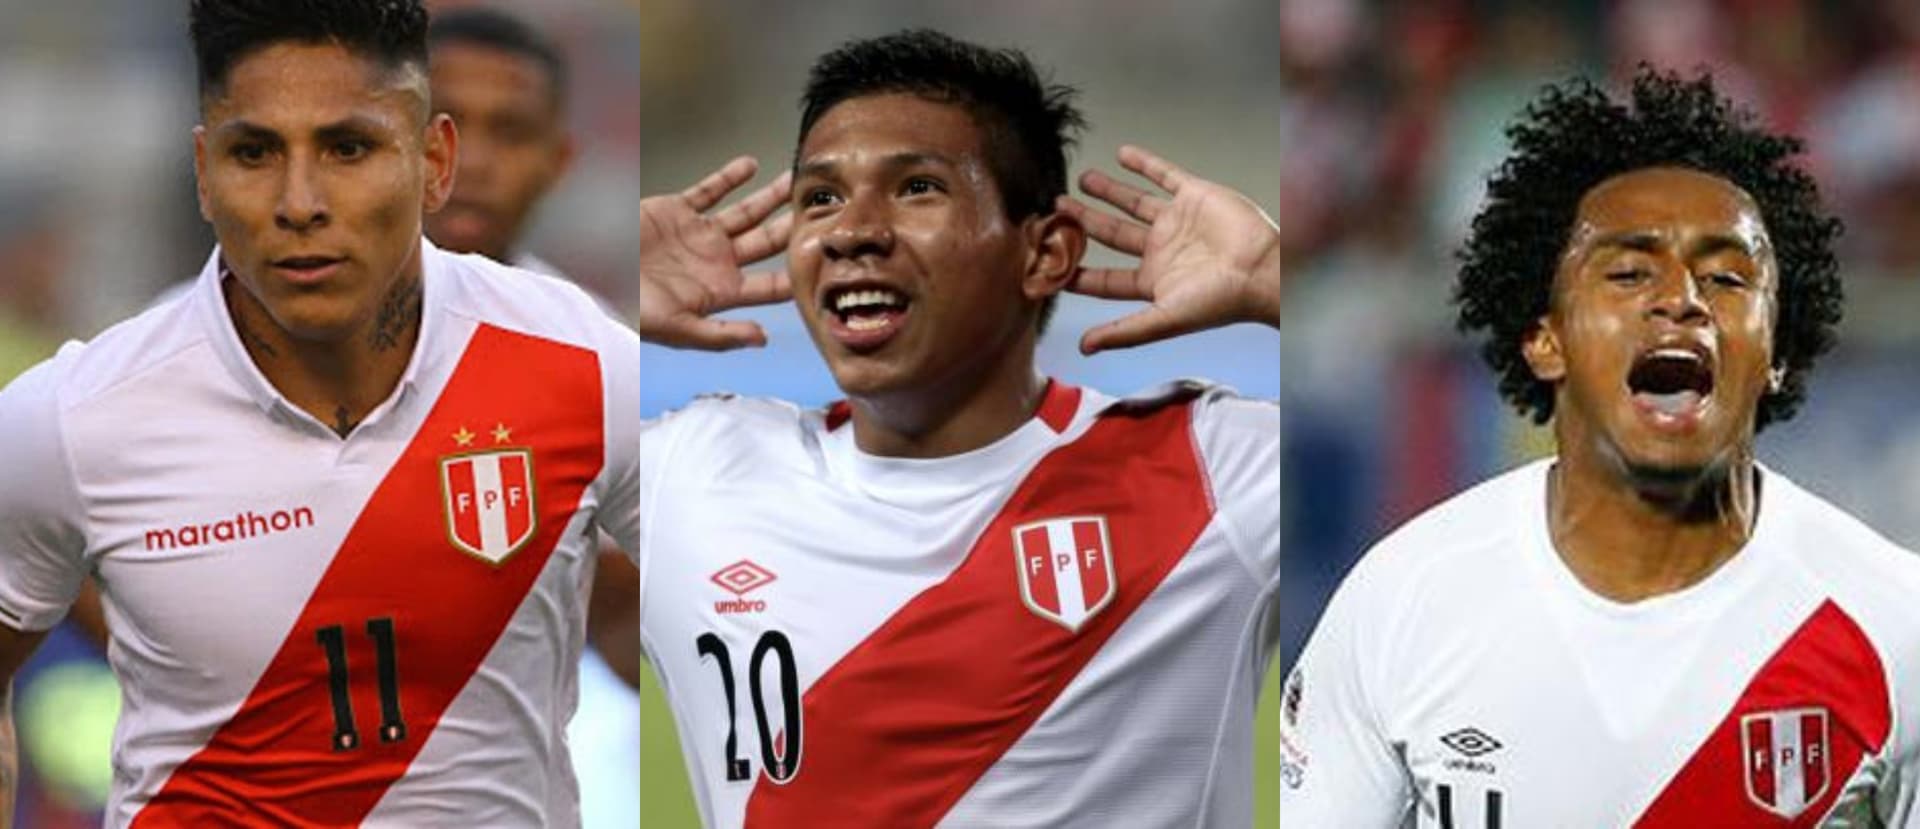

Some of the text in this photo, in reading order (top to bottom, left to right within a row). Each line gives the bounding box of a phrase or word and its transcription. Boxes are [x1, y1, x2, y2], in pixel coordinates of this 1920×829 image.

[145, 506, 314, 550] marathon
[714, 598, 766, 614] umbro
[316, 618, 407, 751] 11
[696, 630, 800, 782] 20
